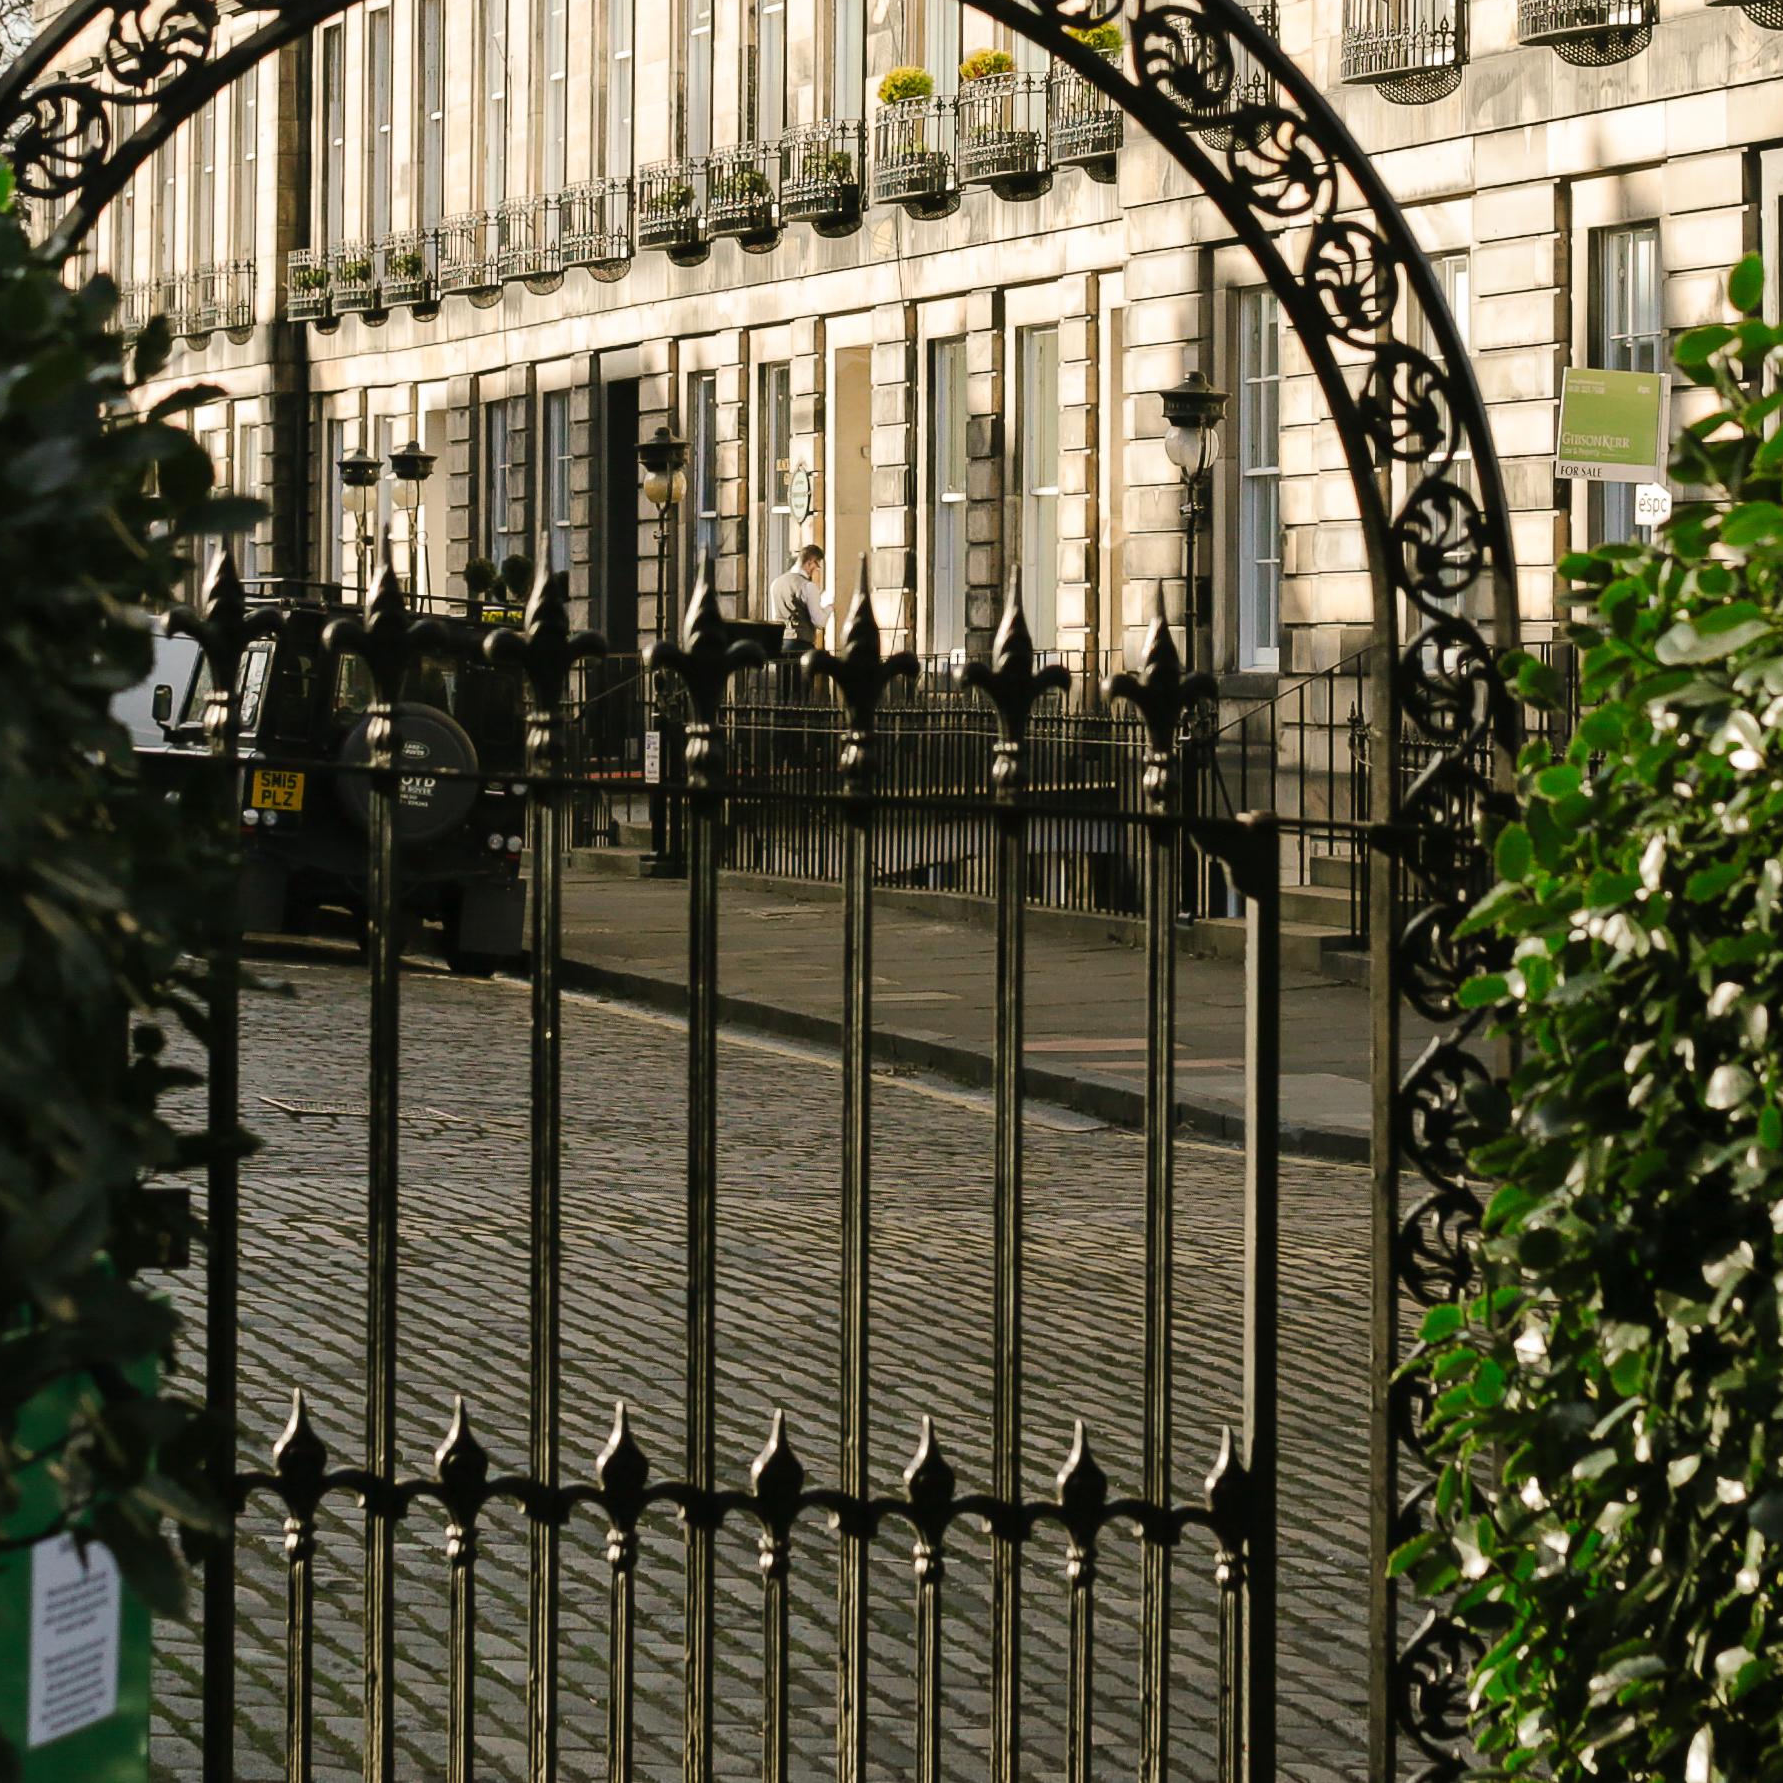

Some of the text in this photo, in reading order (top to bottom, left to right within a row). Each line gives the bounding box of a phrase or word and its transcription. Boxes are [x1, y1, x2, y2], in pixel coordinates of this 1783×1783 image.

[1560, 465, 1603, 478] FOR SALE
[261, 789, 294, 807] PLZ
